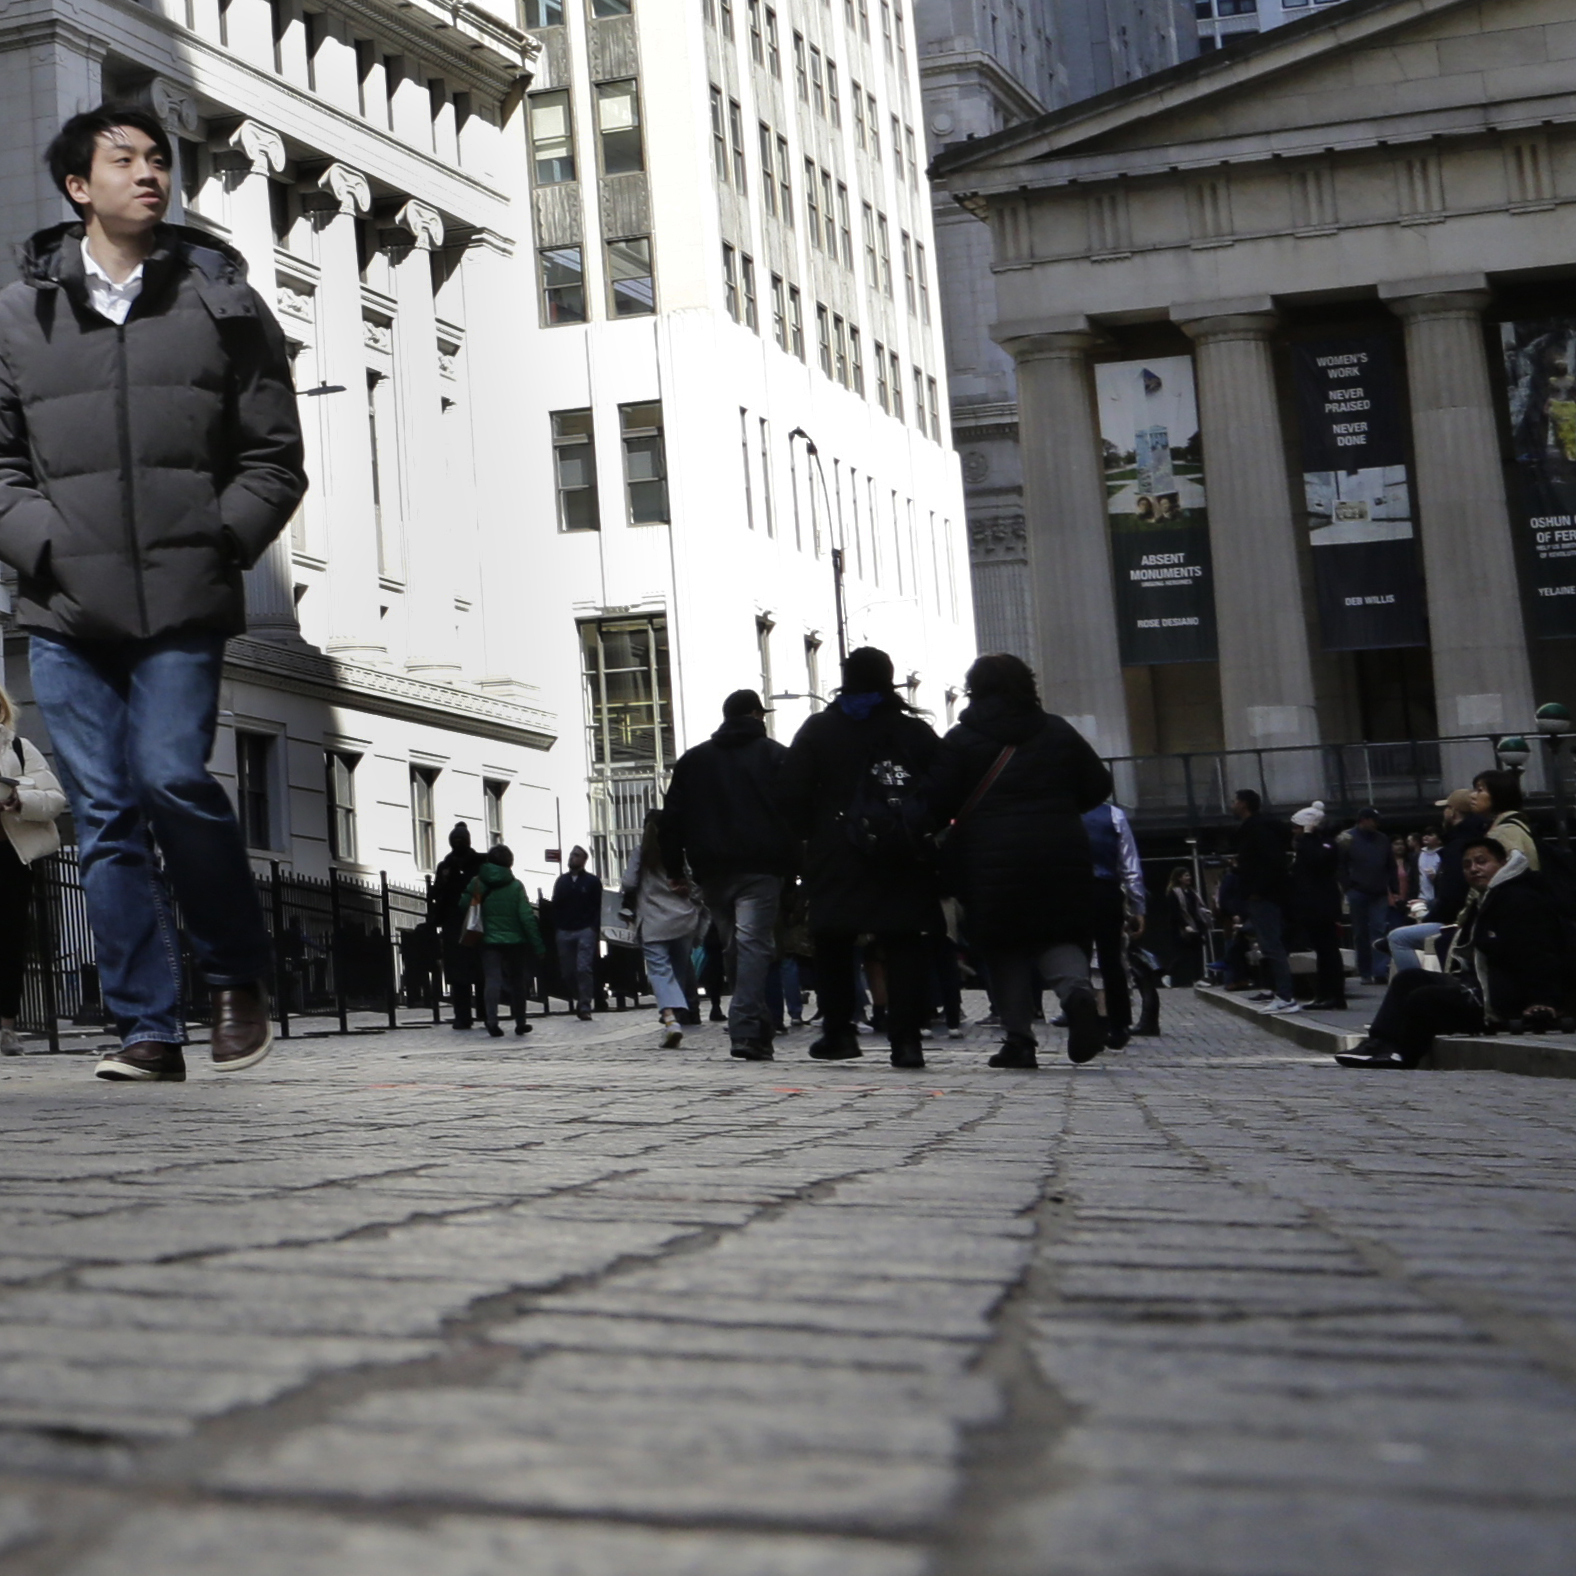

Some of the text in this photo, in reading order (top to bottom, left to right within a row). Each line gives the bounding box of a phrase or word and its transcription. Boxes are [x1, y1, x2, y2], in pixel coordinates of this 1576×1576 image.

[1316, 353, 1368, 367] WOMEN'S
[1327, 367, 1360, 379] WORK
[1329, 388, 1364, 400] NEVER
[1325, 400, 1371, 413] PRAISED
[1333, 422, 1368, 434] NEVER
[1337, 435, 1367, 446] DONE
[1530, 515, 1571, 529] OSHUN
[1536, 531, 1552, 543] OF
[1141, 553, 1185, 566] ABSENT
[1130, 566, 1202, 580] MONUMENTS
